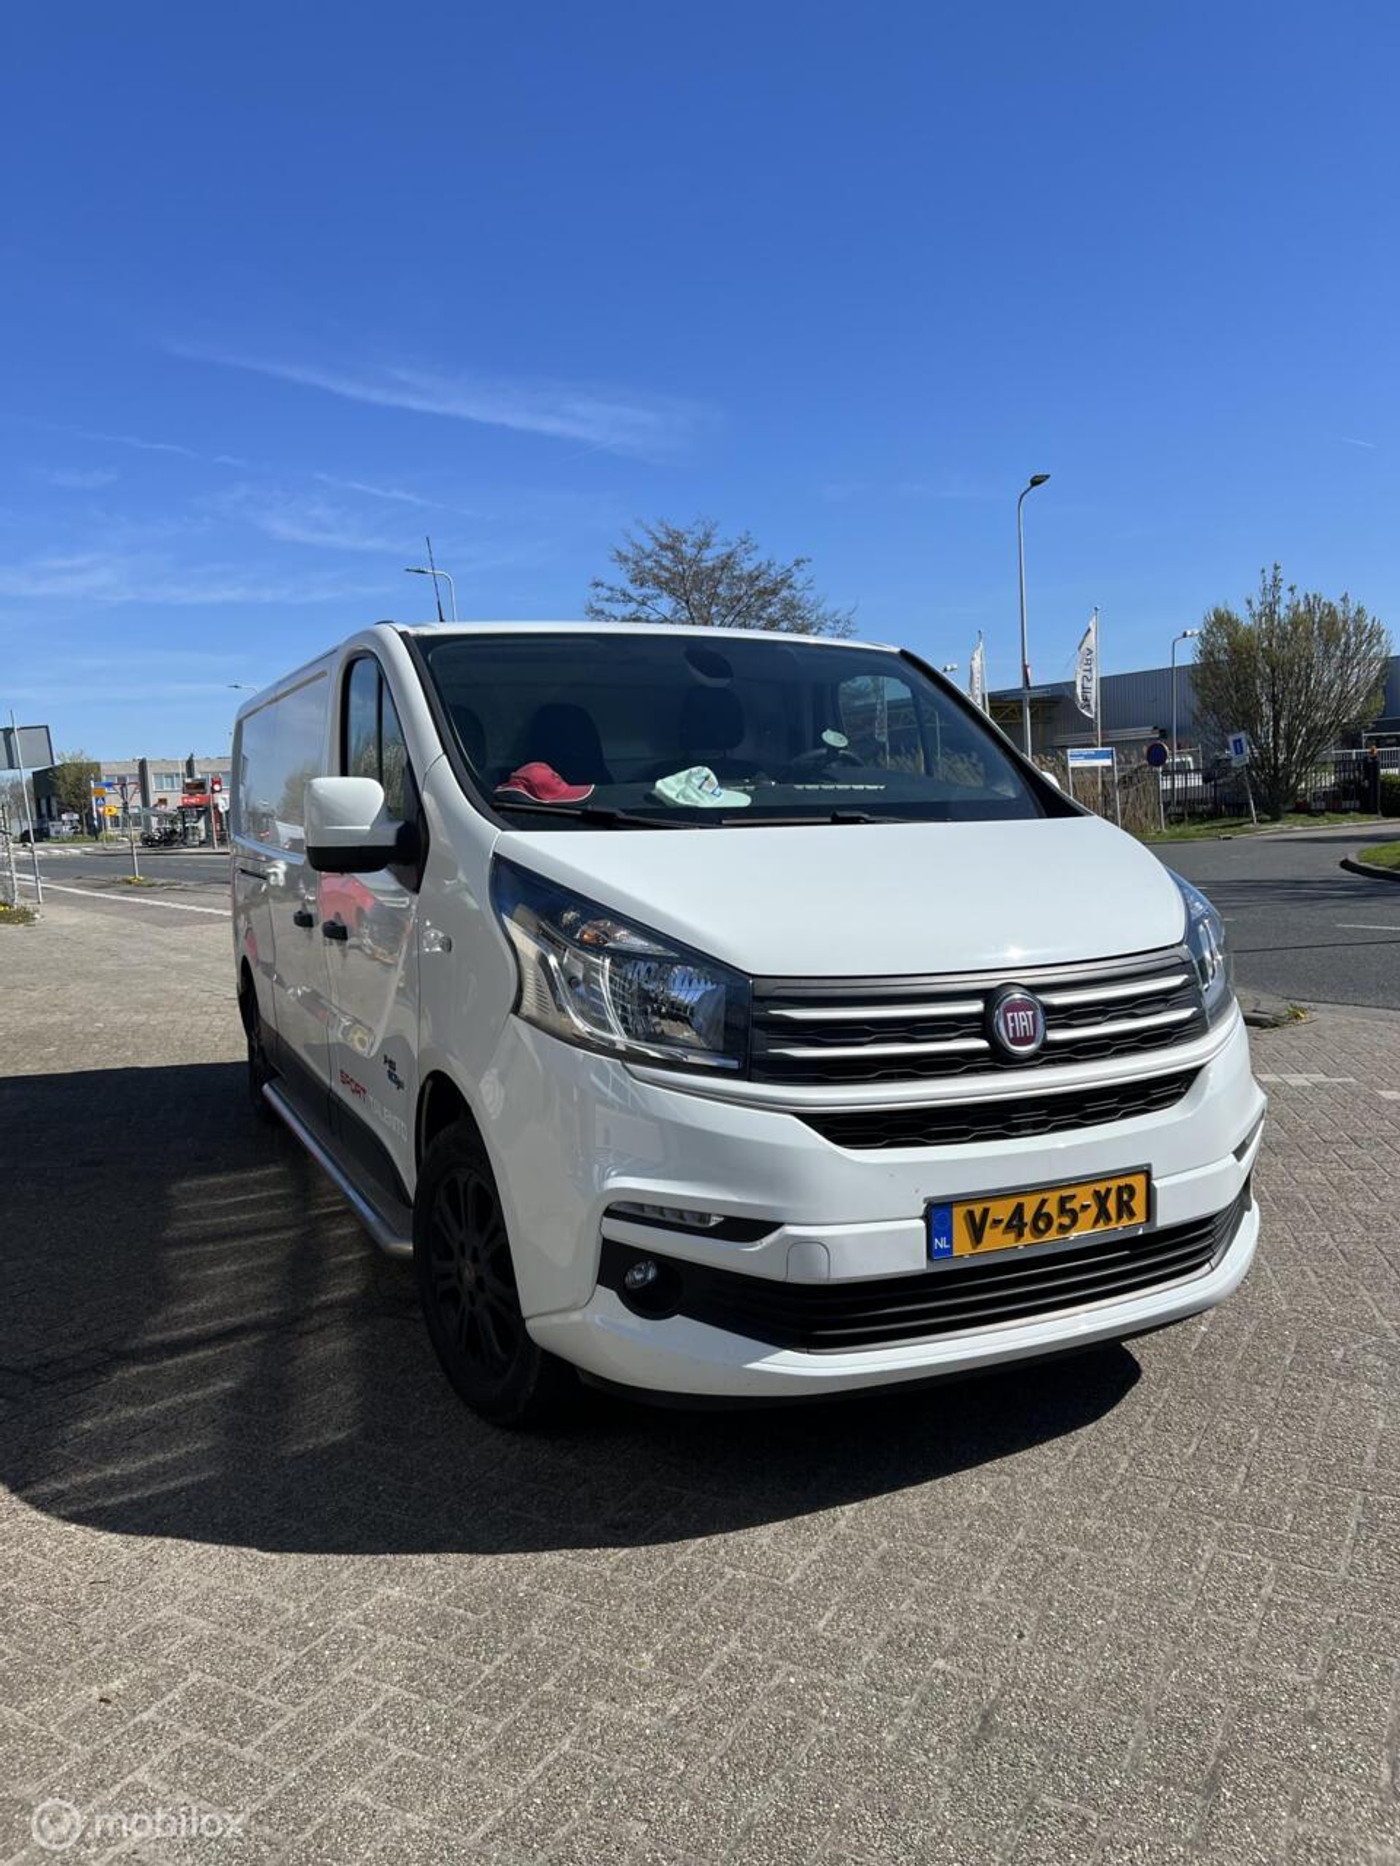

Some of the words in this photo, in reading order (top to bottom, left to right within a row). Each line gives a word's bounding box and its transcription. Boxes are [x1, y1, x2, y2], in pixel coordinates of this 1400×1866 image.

[1006, 1010, 1034, 1039] FIAT
[339, 1069, 367, 1104] SPORT
[964, 1183, 1137, 1248] V-465-XR
[933, 1236, 951, 1250] NL
